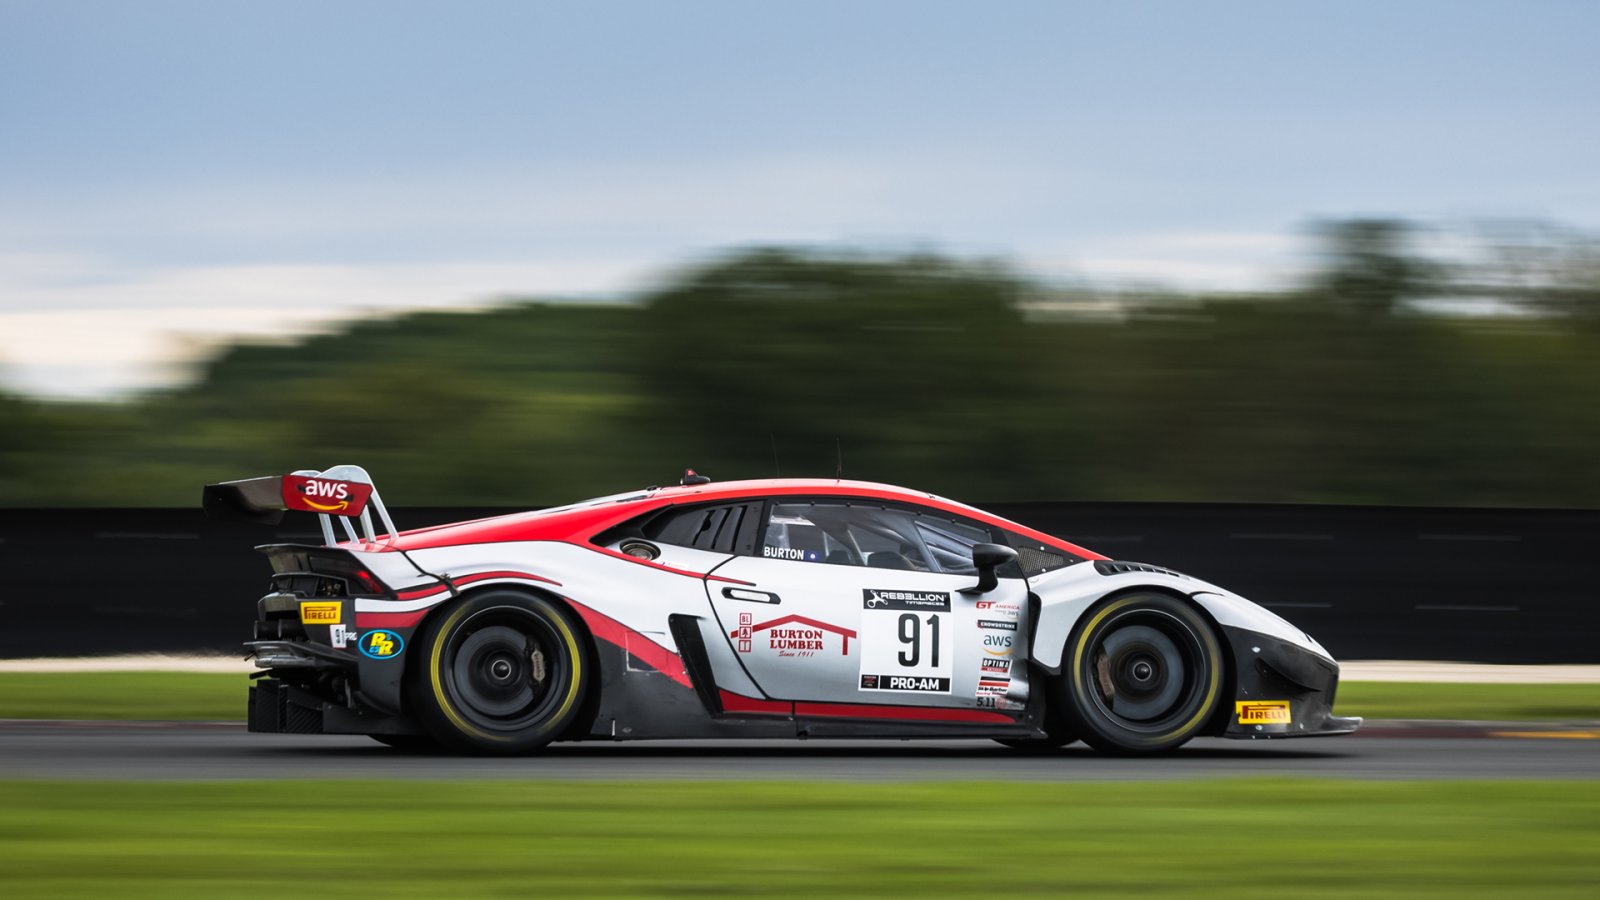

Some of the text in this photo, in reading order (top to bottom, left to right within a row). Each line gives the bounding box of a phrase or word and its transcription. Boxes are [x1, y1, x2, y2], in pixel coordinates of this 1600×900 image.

[305, 480, 348, 499] aws
[764, 546, 804, 560] BURTON
[976, 601, 996, 609] GT
[304, 607, 336, 619] PIRELLI
[770, 629, 823, 639] BURTON
[897, 613, 940, 667] 91
[984, 634, 1012, 647] aws
[770, 640, 823, 650] LUMBER
[983, 660, 1009, 668] OPTIMA
[890, 677, 939, 690] PRO-AM
[1242, 705, 1286, 719] PIRELLI
